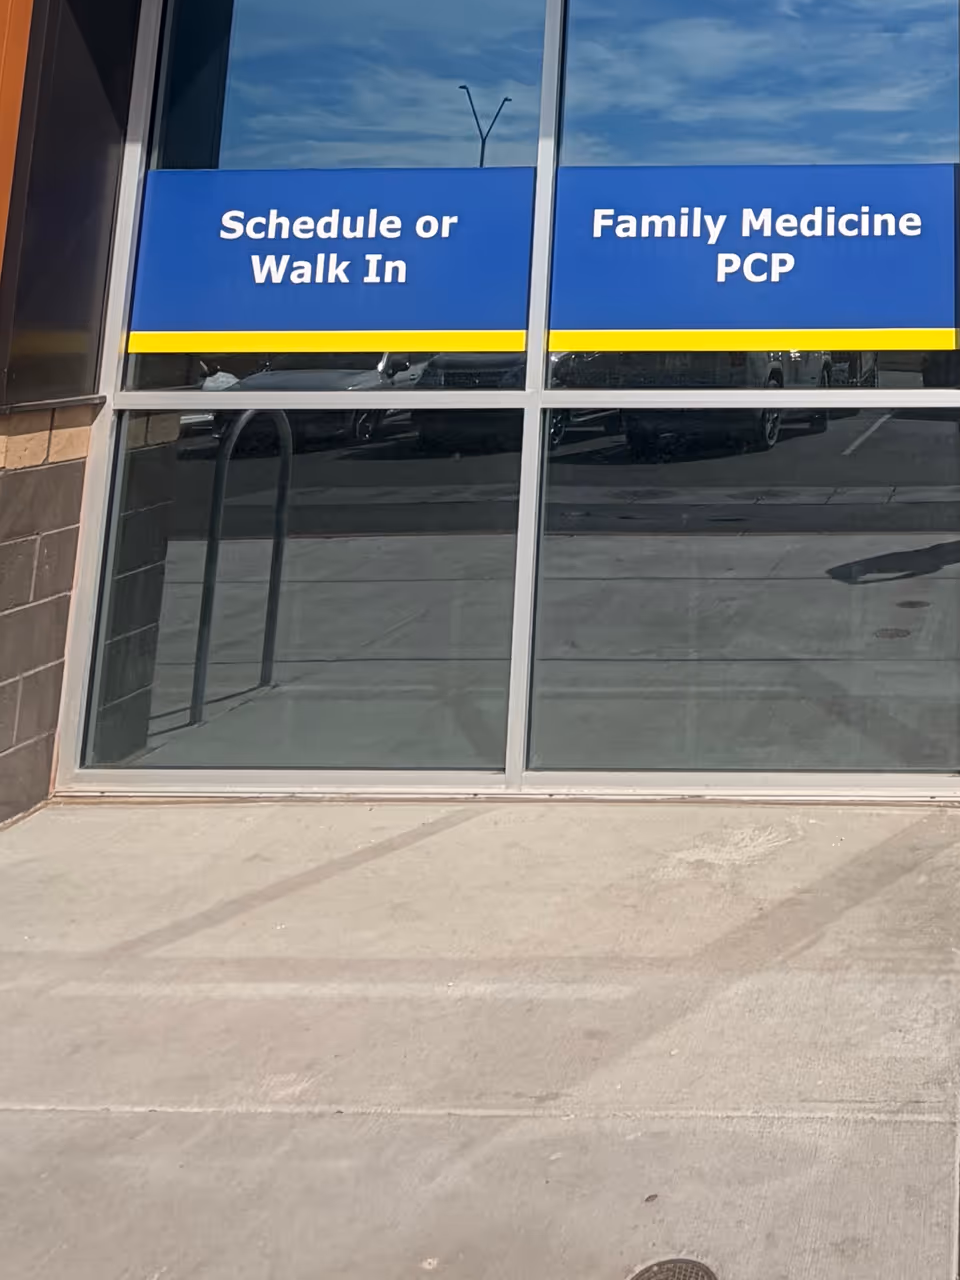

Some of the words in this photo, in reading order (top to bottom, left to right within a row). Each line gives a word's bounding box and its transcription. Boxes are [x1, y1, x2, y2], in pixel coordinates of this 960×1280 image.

[219, 208, 402, 240] Schedule
[415, 214, 459, 238] or
[592, 206, 728, 245] Family
[741, 206, 923, 238] Medicine
[251, 253, 351, 284] Walk
[363, 253, 407, 283] In
[716, 252, 796, 283] PCP
